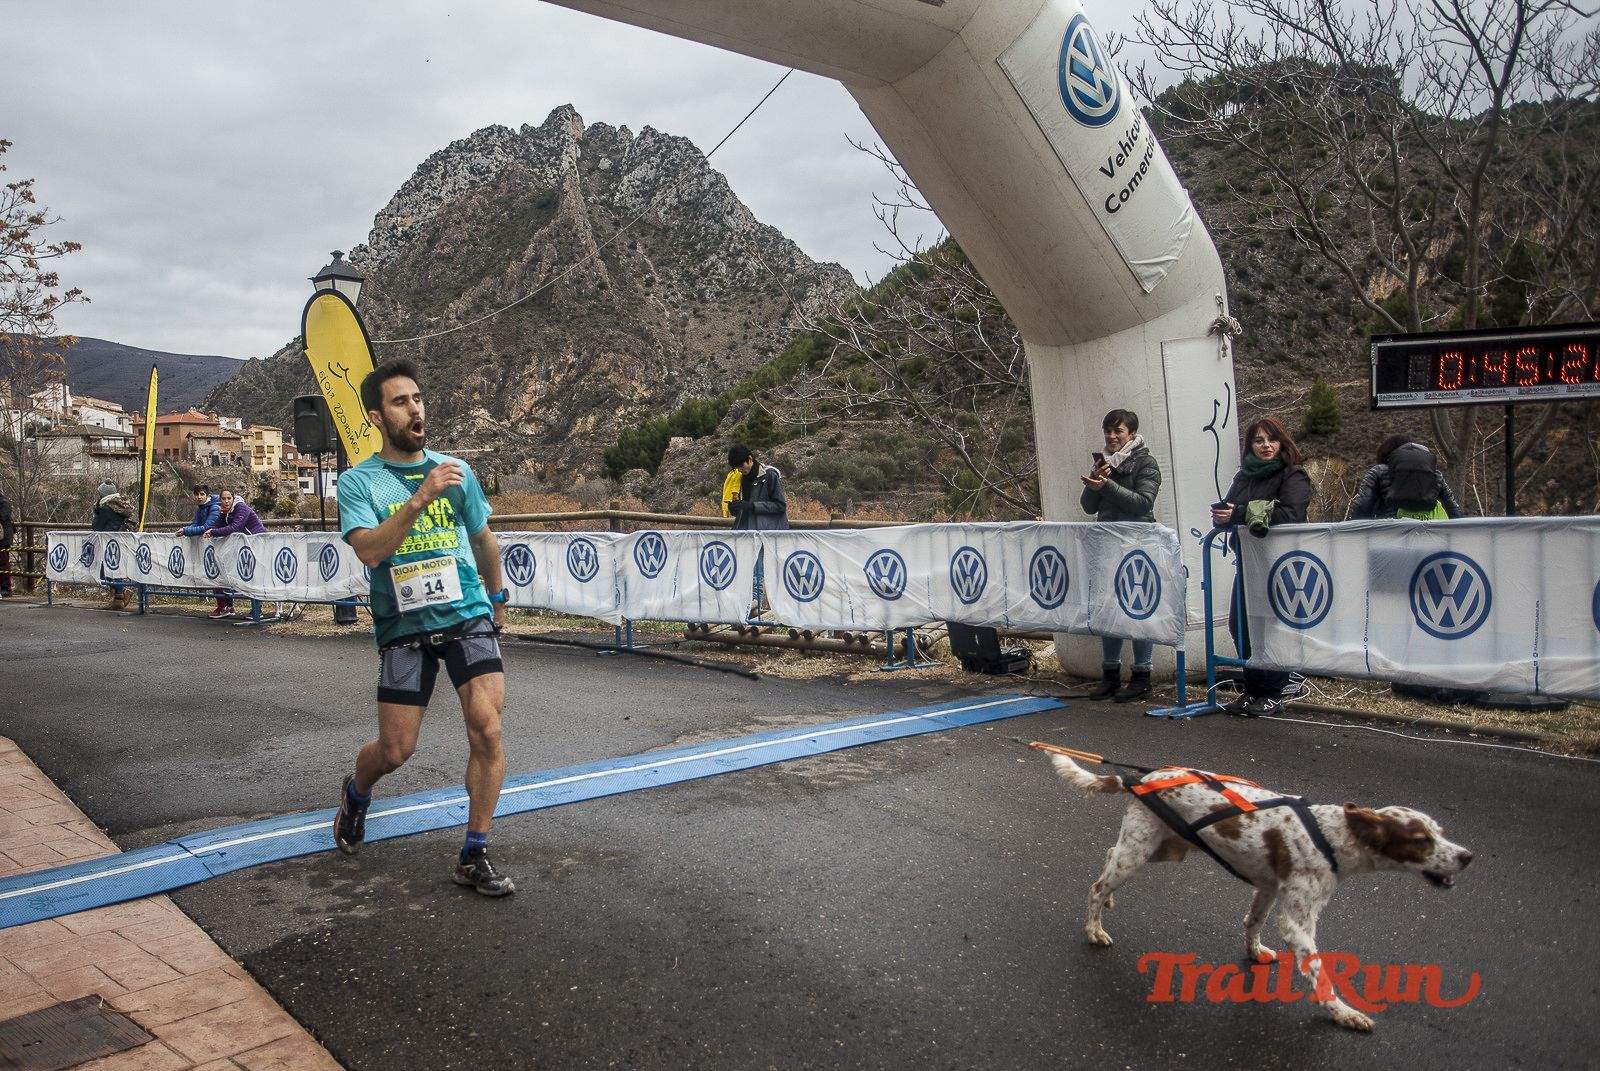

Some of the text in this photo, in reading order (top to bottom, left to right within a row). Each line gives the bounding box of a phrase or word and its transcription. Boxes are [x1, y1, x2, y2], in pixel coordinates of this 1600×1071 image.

[1438, 343, 1600, 390] 0:45:2
[393, 558, 454, 576] RIOJA MOTOR
[424, 579, 445, 596] 14
